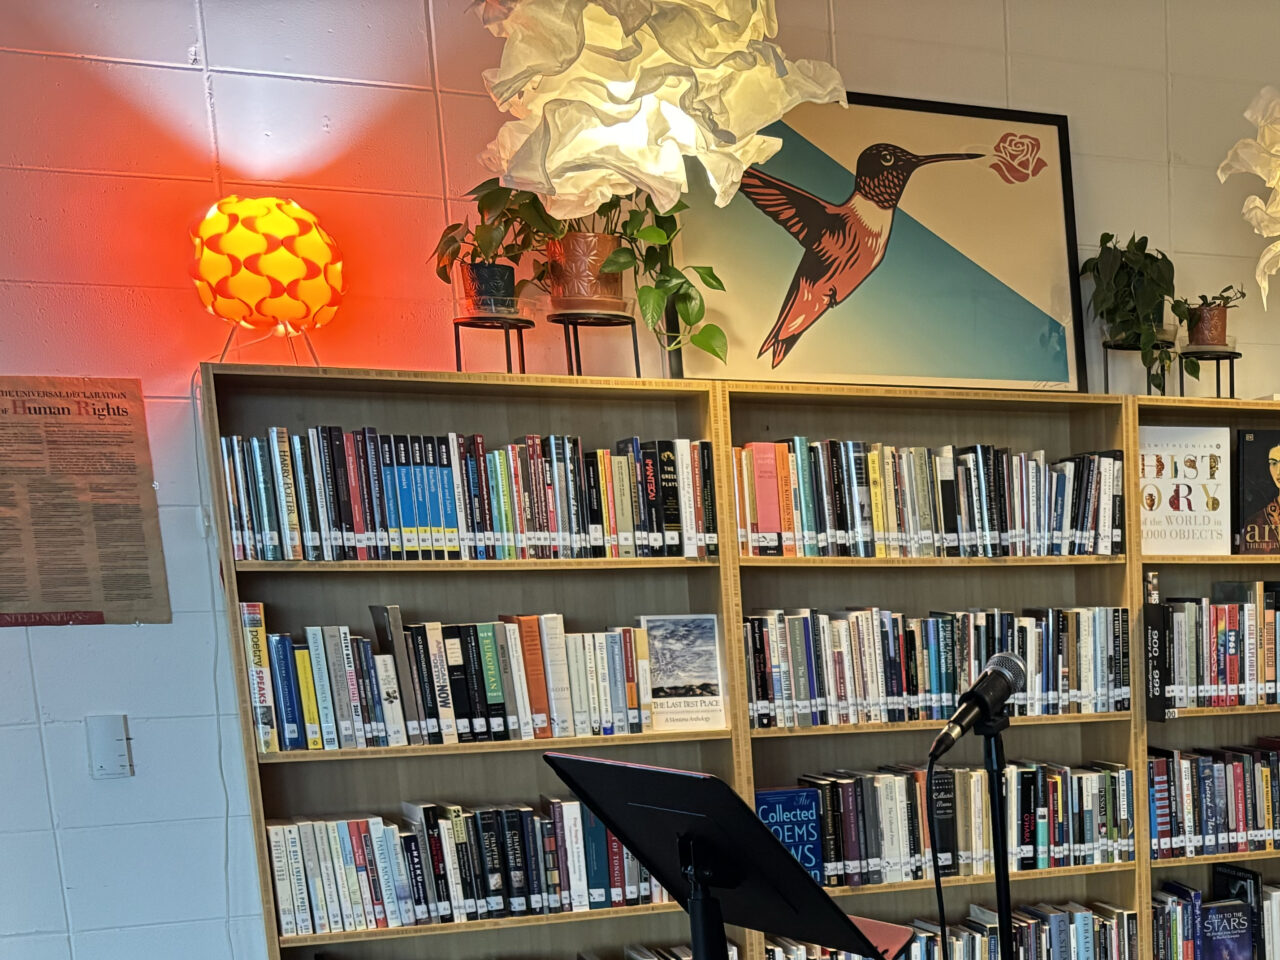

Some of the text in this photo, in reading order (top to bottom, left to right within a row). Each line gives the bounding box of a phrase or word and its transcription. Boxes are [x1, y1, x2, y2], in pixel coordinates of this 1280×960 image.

[12, 399, 129, 420] Human Rights
[15, 390, 127, 400] UNIVERSAL DECLARATION
[1138, 453, 1222, 480] HIST
[279, 450, 295, 516] HARRY POTTER
[1140, 483, 1222, 512] ORY
[1149, 515, 1211, 526] the WORLD
[1169, 529, 1223, 540] OBJECTS
[1228, 631, 1236, 654] 1968
[1248, 623, 1256, 641] GIRL
[249, 630, 267, 705] poetry SPEAKS
[435, 639, 447, 684] AMERICAN
[483, 639, 497, 691] EUROPEAN
[1151, 630, 1160, 696] 900 999
[437, 684, 451, 709] NOW
[666, 700, 682, 709] LAST
[699, 699, 720, 707] PLACE
[1205, 778, 1214, 807] Vincent
[758, 801, 817, 824] Collected
[771, 822, 818, 843] OEMS
[488, 831, 499, 868] CHAPTERS
[511, 831, 521, 867] CHAPTERS
[293, 866, 305, 895] AMERICAN
[374, 836, 395, 905] HAIKU MOMENT
[413, 851, 423, 882] HAIKU
[1083, 916, 1092, 947] GERALD
[1203, 916, 1248, 933] STARS
